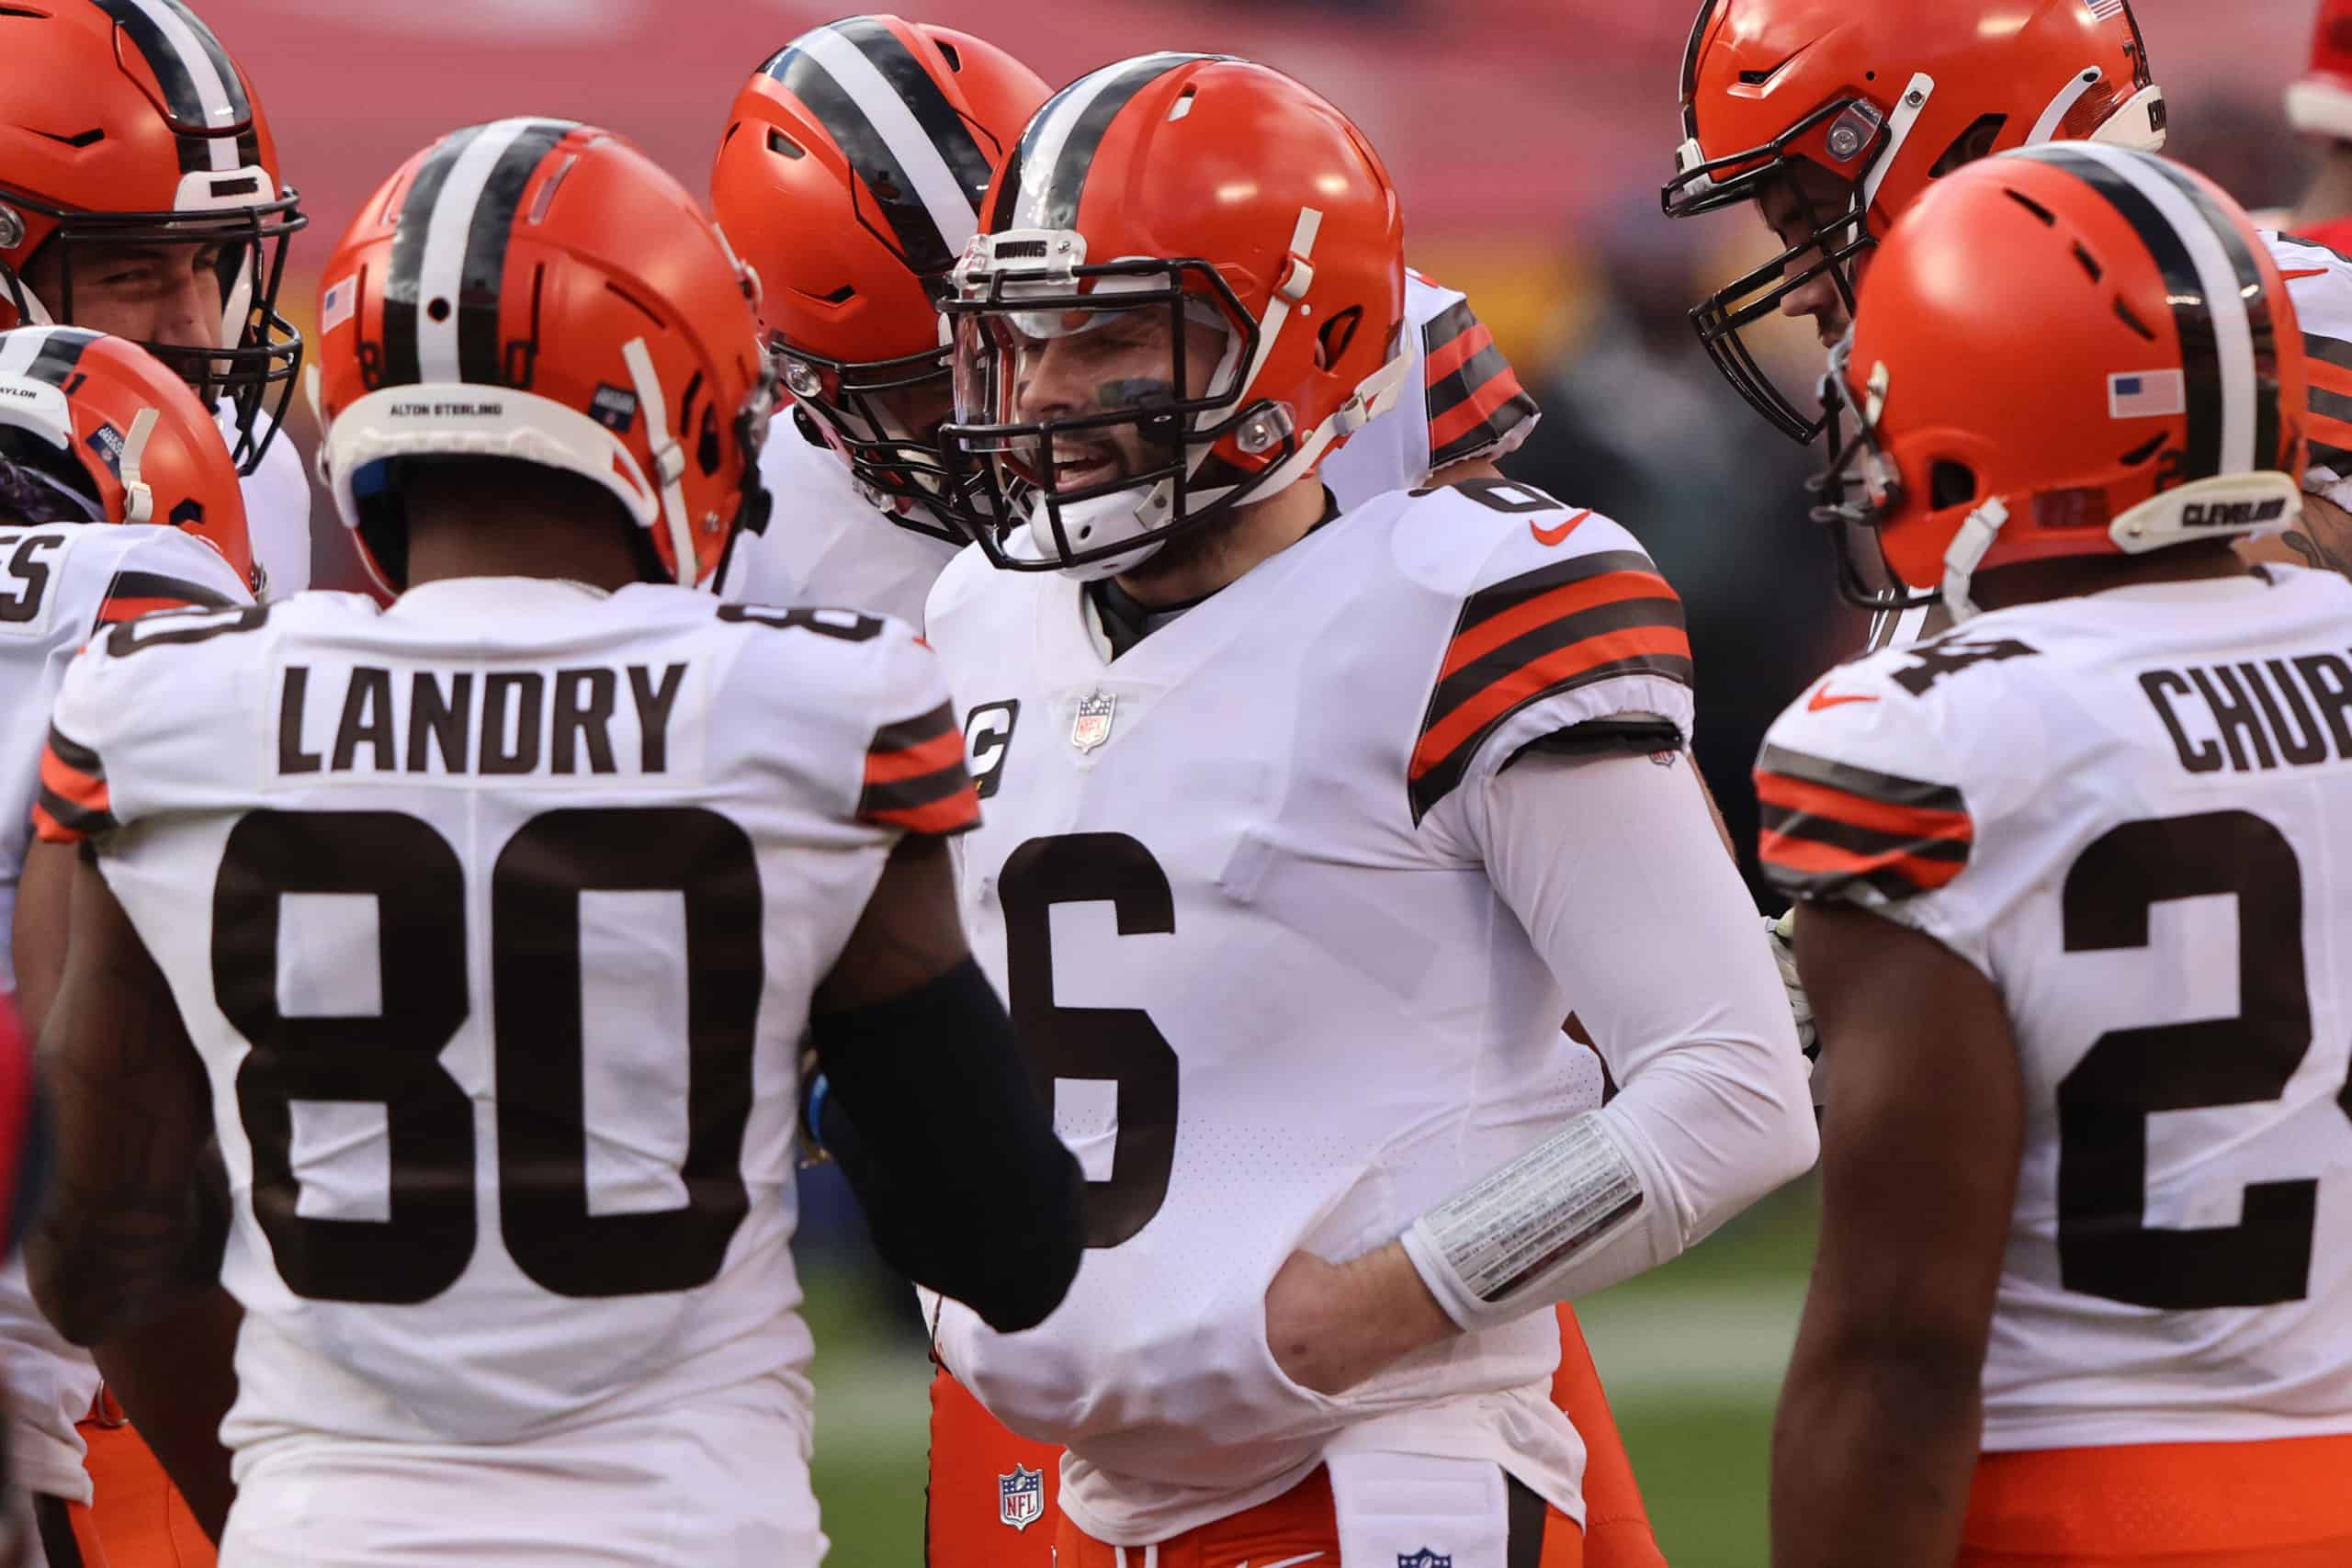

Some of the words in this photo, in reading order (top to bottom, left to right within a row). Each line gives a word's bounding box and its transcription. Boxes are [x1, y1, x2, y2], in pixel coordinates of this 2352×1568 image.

[390, 403, 430, 416] ALTON
[434, 403, 503, 416] STERLING
[278, 663, 686, 774] LANDRY
[966, 706, 1011, 778] C
[2139, 647, 2352, 773] CHUB
[212, 807, 764, 1305] 80
[998, 831, 1180, 1249] 6
